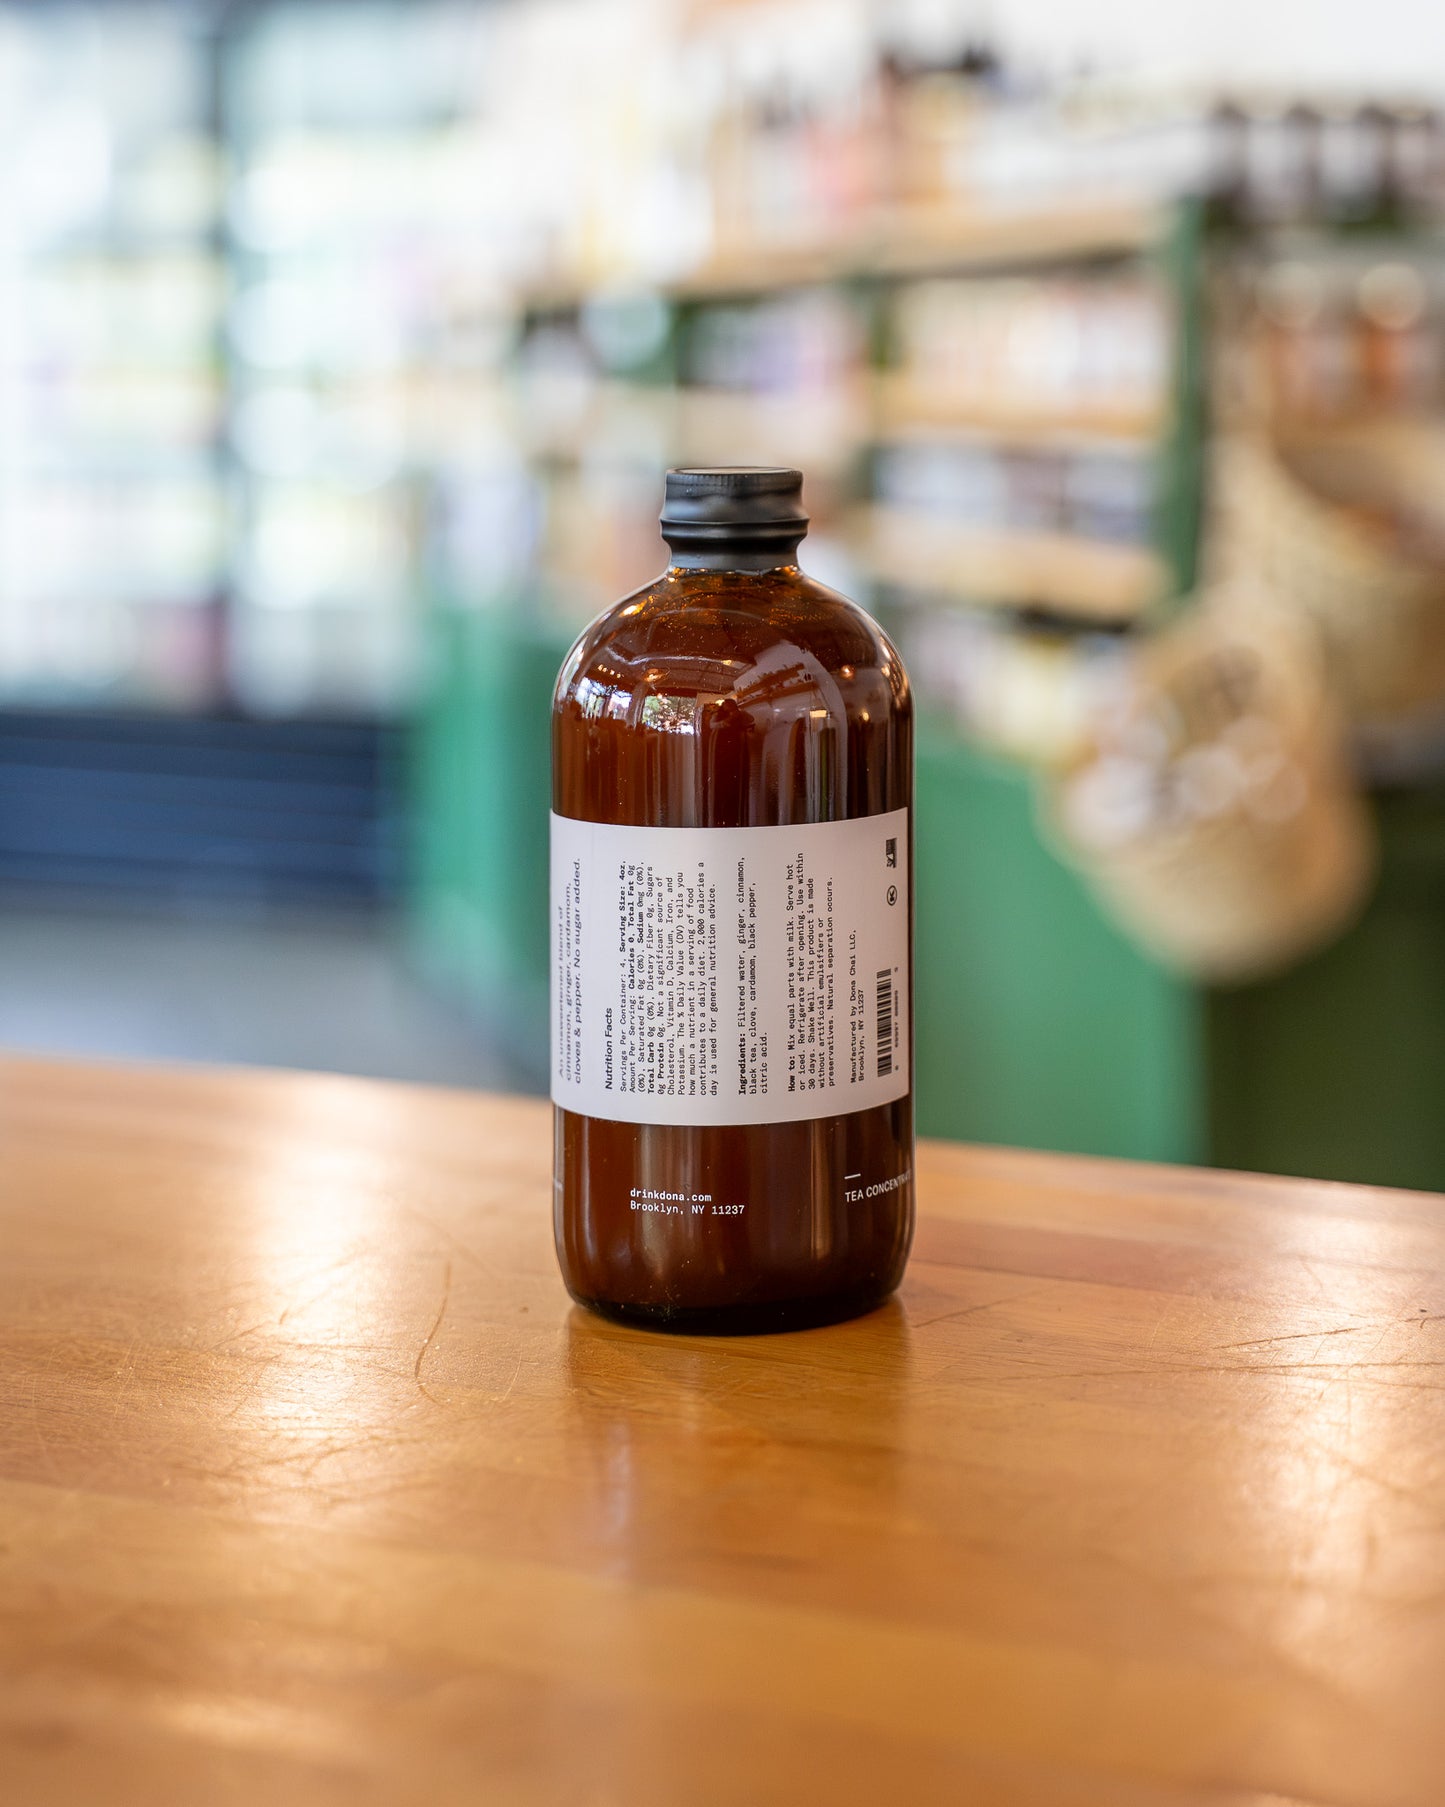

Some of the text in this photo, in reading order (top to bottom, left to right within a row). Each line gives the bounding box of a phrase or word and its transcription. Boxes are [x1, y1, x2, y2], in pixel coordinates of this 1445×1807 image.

[627, 865, 636, 876] 0g
[677, 872, 685, 888] you
[796, 853, 804, 884] within
[646, 867, 654, 897] Sugars
[655, 877, 663, 887] of
[665, 877, 673, 893] and
[696, 873, 705, 914] calories
[806, 878, 814, 899] made
[636, 891, 645, 907] 0mg
[675, 893, 684, 919] tells
[686, 888, 694, 908] food
[786, 885, 794, 911] Serve
[796, 889, 804, 905] Use
[806, 904, 814, 914] is
[574, 908, 582, 945] sugar
[636, 912, 644, 944] Sodium
[686, 914, 694, 924] of
[697, 918, 706, 945] 2,000
[818, 918, 824, 928] or
[619, 916, 627, 952] Serving
[646, 923, 654, 949] Fiber
[676, 925, 685, 944] (DV)
[687, 929, 696, 965] serving
[747, 923, 756, 949] black
[807, 919, 816, 955] product
[826, 917, 834, 968] separation
[655, 928, 666, 985] significant
[707, 924, 716, 971] nutrition
[786, 946, 794, 968] with
[646, 954, 655, 991] Dietary
[676, 950, 684, 976] Value
[797, 956, 805, 982] after
[816, 933, 824, 990] emulsifiers
[637, 979, 646, 990] 0g
[676, 981, 686, 1007] Daily
[687, 981, 695, 991] in
[697, 981, 707, 1007] daily
[708, 976, 719, 1012] general
[787, 972, 796, 998] parts
[826, 973, 834, 1010] Natural
[637, 995, 645, 1010] Fat
[666, 991, 674, 1028] Vitamin
[737, 986, 745, 1027] Filtered
[797, 987, 807, 1044] Refrigerate
[850, 1006, 857, 1016] by
[628, 996, 637, 1036] Serving:
[687, 997, 695, 1038] nutrient
[699, 1022, 706, 1033] to
[708, 1017, 717, 1033] for
[787, 1003, 796, 1029] equal
[817, 995, 825, 1047] artificial
[858, 1020, 864, 1030] NY
[637, 1015, 645, 1063] Saturated
[647, 1026, 656, 1037] 0g
[677, 1023, 685, 1038] The
[787, 1034, 795, 1050] Mix
[807, 1017, 815, 1043] Shake
[604, 1008, 613, 1090] Nutrition Facts
[628, 1041, 636, 1056] Per
[647, 1042, 655, 1063] Carb
[657, 1042, 665, 1079] Protein
[709, 1038, 717, 1059] used
[620, 1050, 628, 1092] Servings
[688, 1054, 696, 1075] much
[698, 1038, 707, 1096] contributes
[709, 1064, 717, 1074] is
[738, 1033, 748, 1095] Ingredients:
[647, 1068, 655, 1094] Total
[657, 1084, 666, 1095] 0g
[688, 1079, 696, 1095] how
[709, 1080, 719, 1096] day
[749, 1068, 757, 1094] black
[759, 1062, 768, 1094] citric
[788, 1075, 796, 1092] How
[800, 1080, 806, 1091] or
[808, 1078, 816, 1090] 30
[630, 1187, 712, 1202] drinkdona.com
[630, 1200, 745, 1215] Brooklyn, NY 11237
[844, 1189, 864, 1203] TEA
